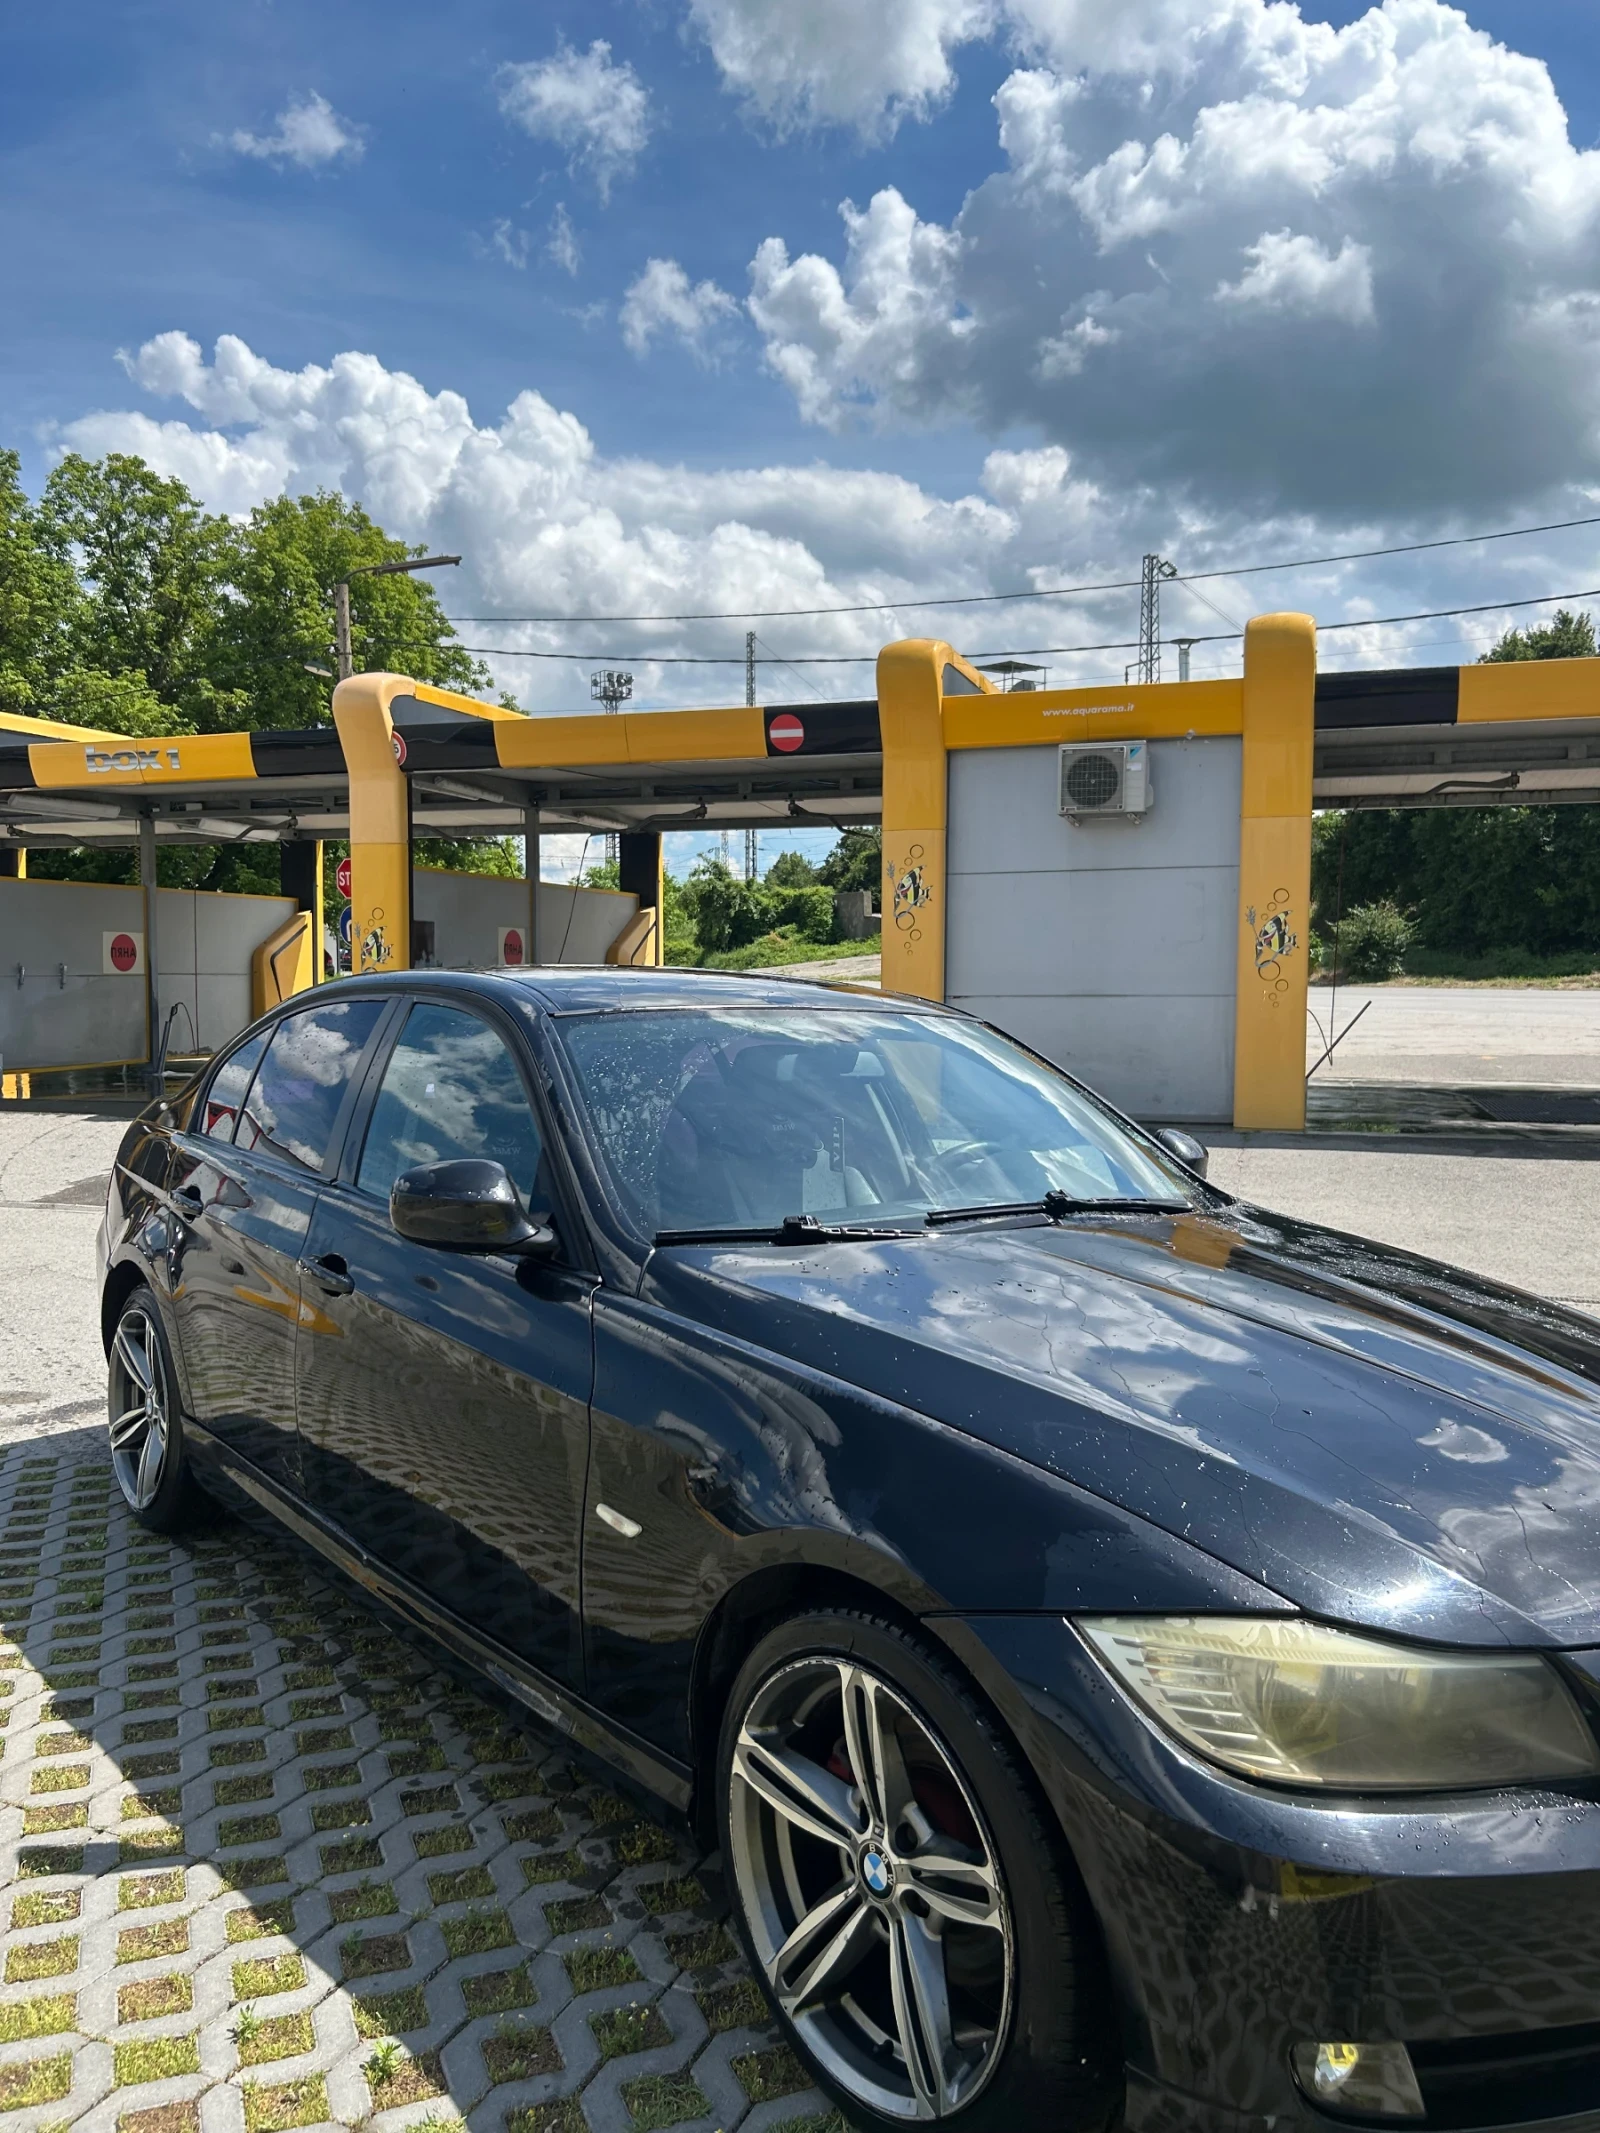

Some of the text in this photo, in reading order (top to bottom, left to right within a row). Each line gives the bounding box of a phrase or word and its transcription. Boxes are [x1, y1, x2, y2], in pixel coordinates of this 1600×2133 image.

[1042, 703, 1135, 717] www.aquarama.it
[85, 745, 181, 773] box 1
[338, 871, 351, 887] ST
[110, 946, 137, 958] ПЯНА
[868, 1843, 894, 1886] BMW
